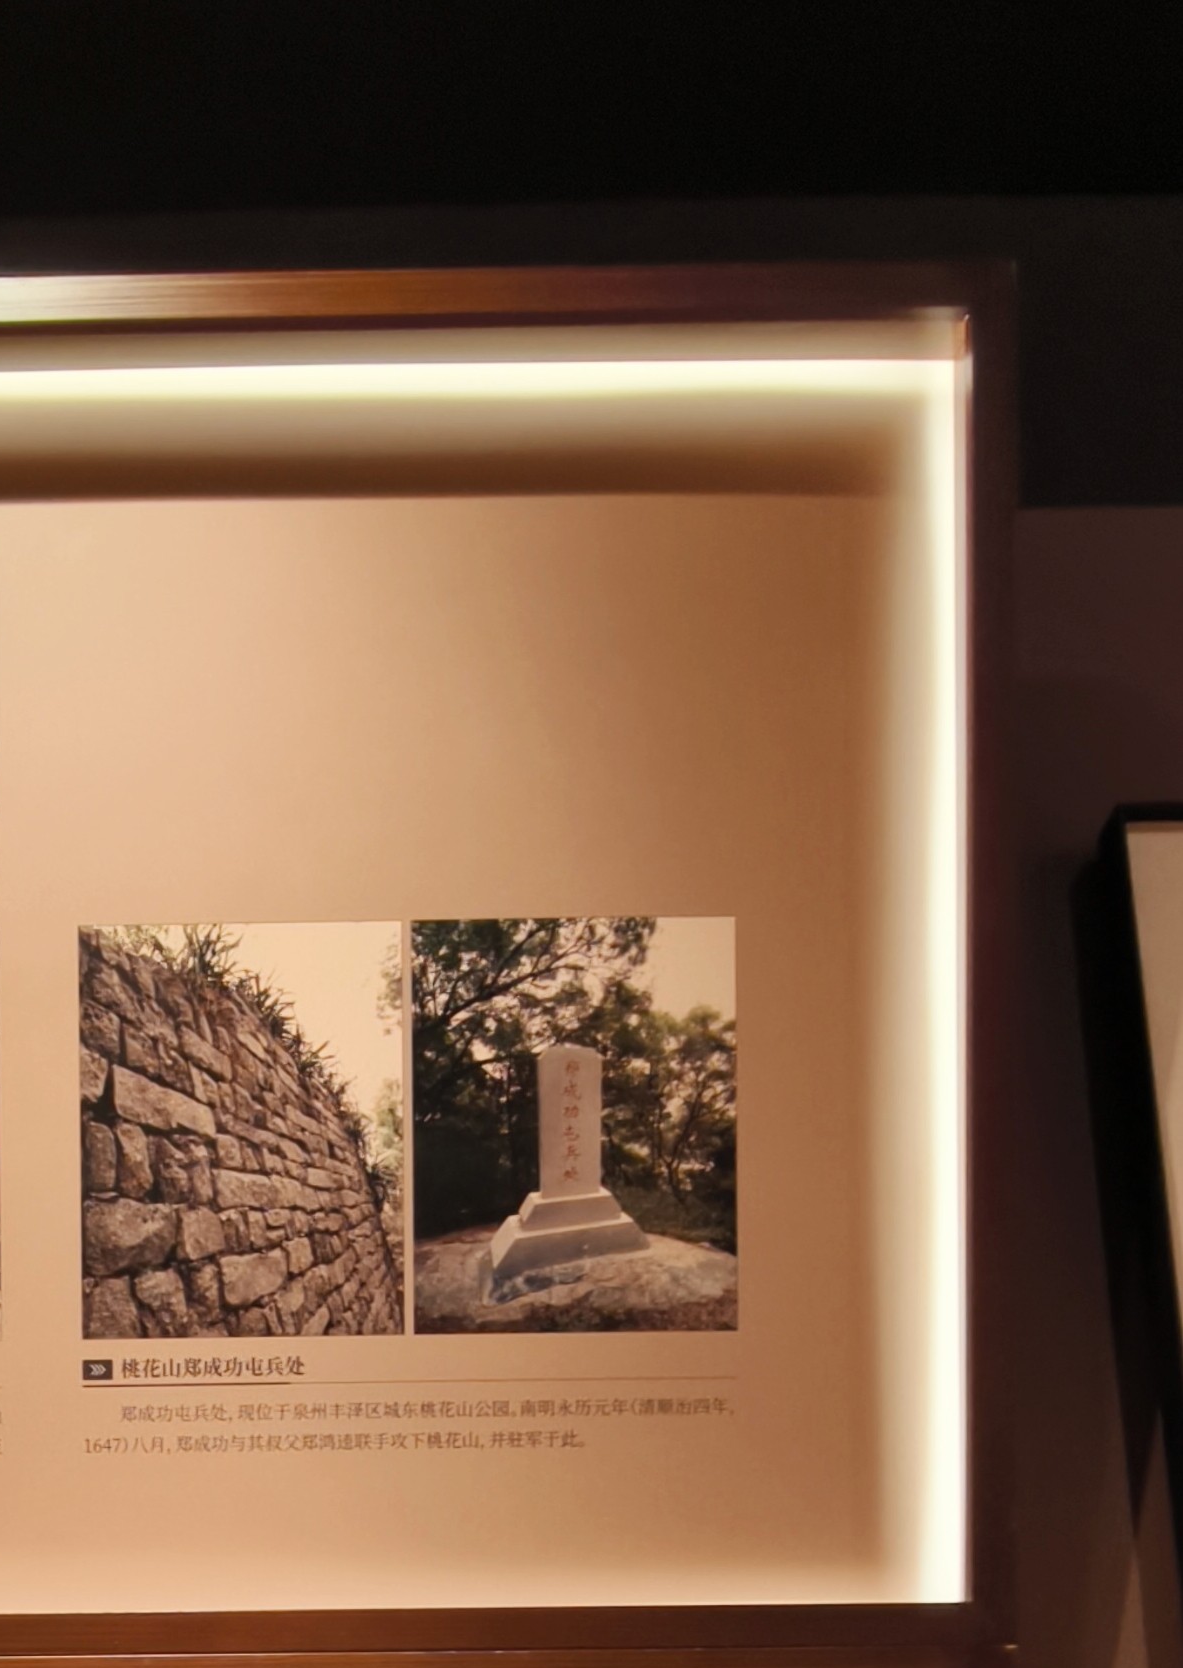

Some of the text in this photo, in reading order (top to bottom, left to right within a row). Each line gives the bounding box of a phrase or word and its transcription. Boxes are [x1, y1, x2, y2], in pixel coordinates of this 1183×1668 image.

[120, 1355, 306, 1380] 桃花山郑成功屯兵处
